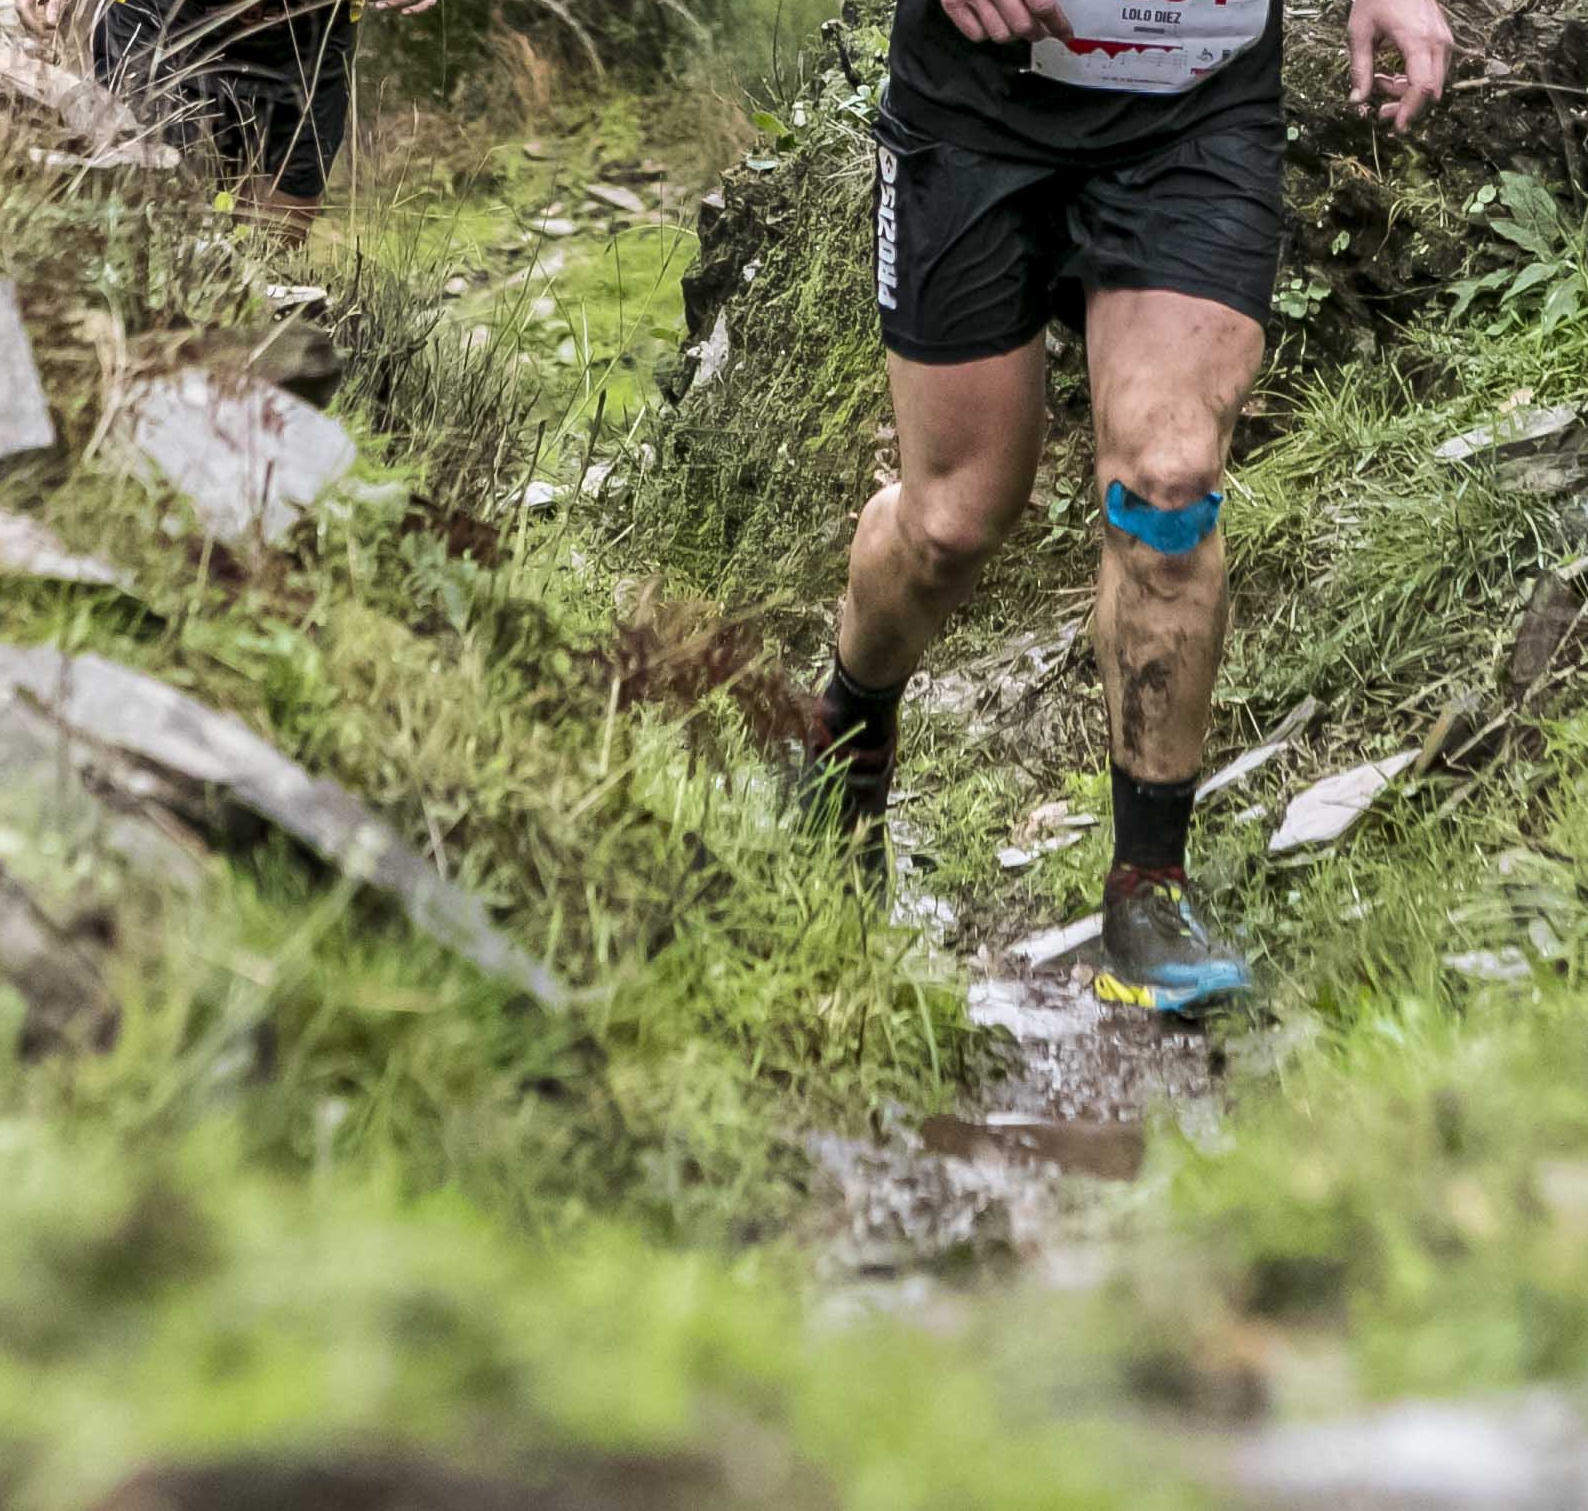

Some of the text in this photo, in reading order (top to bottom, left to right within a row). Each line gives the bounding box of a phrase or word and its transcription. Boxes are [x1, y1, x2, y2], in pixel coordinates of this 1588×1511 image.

[1122, 8, 1182, 24] LOLO DIEZ
[877, 184, 899, 311] PROZIS
